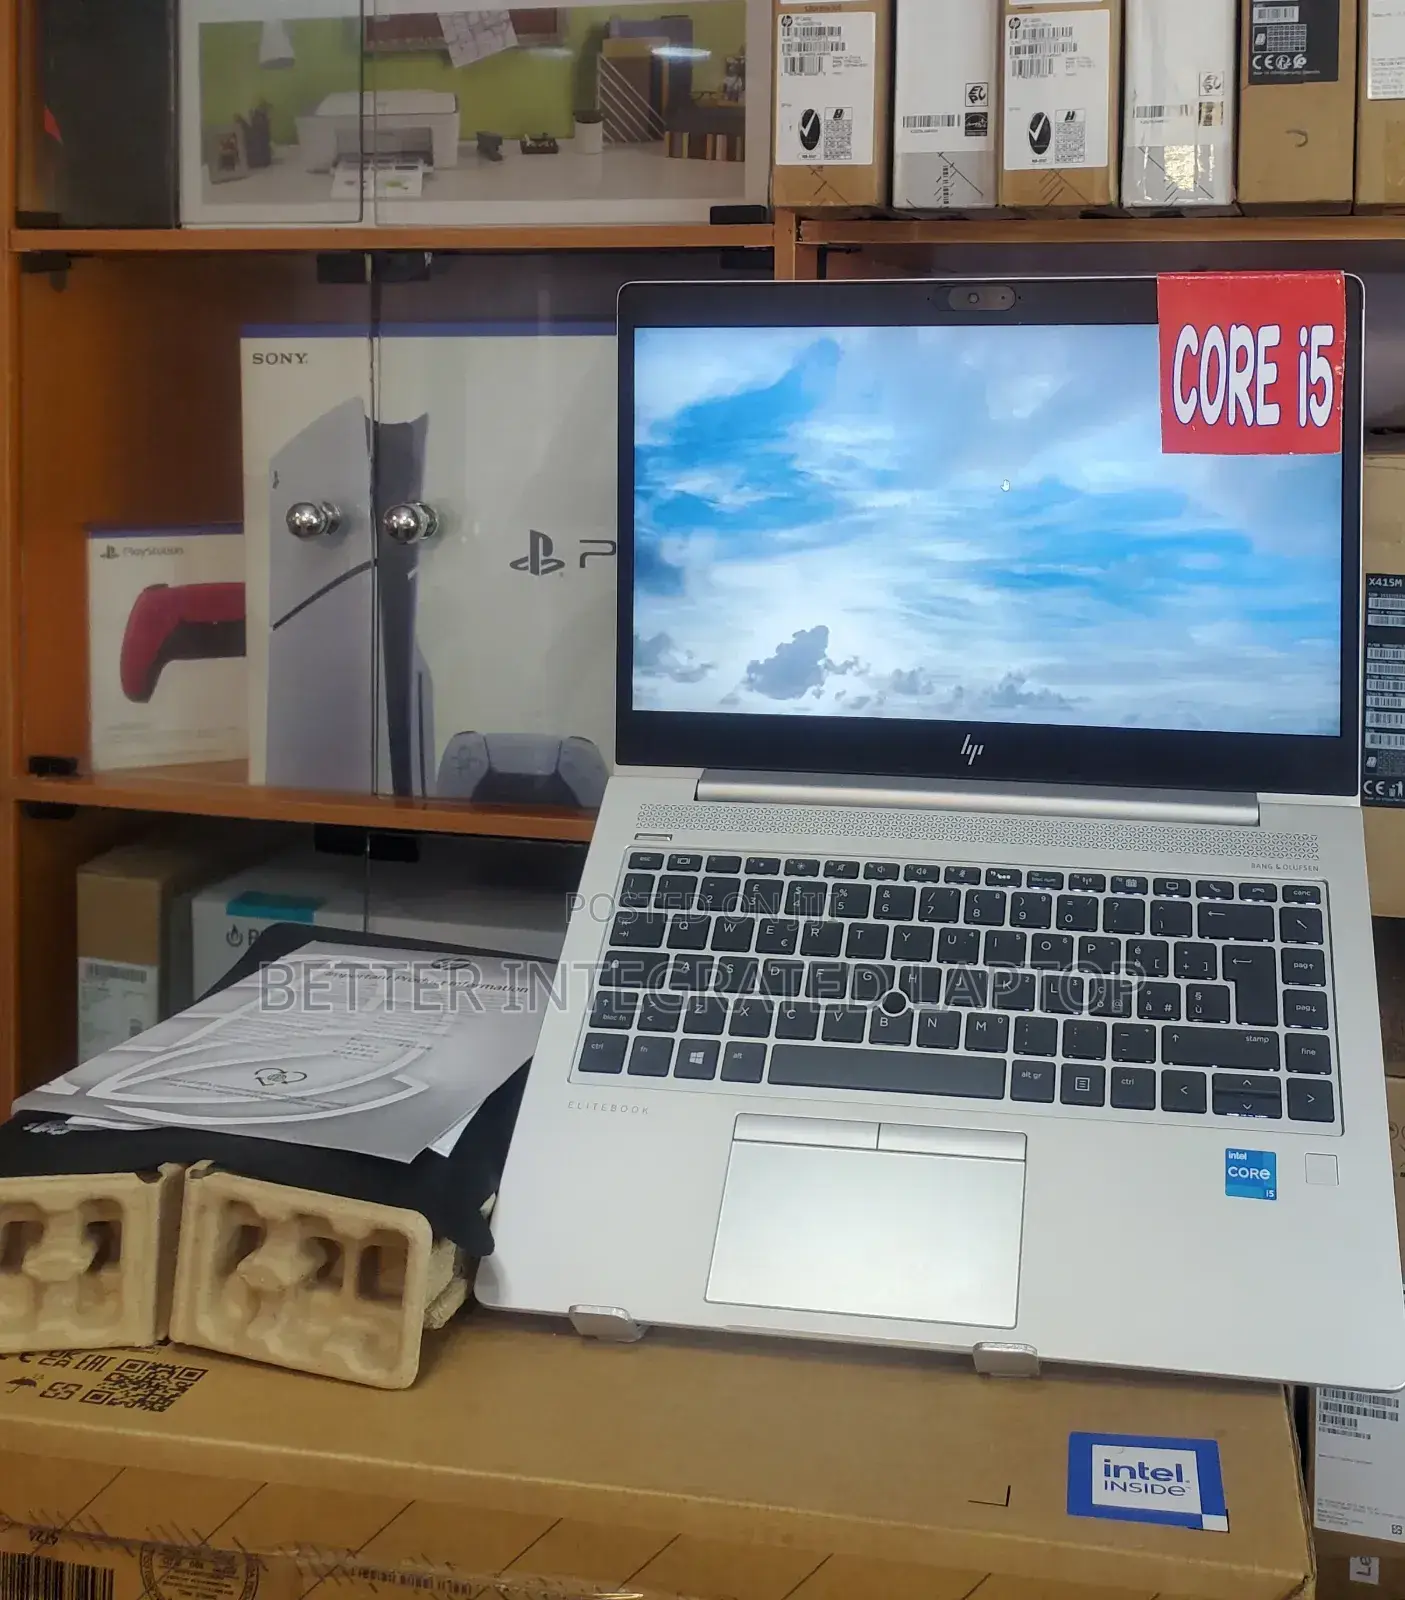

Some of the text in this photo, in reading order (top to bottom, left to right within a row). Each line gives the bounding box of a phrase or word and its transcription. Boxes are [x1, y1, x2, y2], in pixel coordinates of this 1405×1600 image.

[252, 352, 309, 365] SONY
[1172, 324, 1335, 428] CORE i5
[1251, 862, 1273, 870] BANG
[1282, 864, 1319, 872] OLUFSEN
[679, 921, 689, 931] Q
[723, 923, 737, 932] W
[766, 925, 774, 934] E
[811, 928, 820, 937] R
[856, 930, 864, 939] T
[902, 932, 911, 942] Y
[780, 939, 788, 947] €
[948, 935, 957, 944] U
[1088, 944, 1096, 953] P
[1293, 962, 1308, 970] pag
[694, 1004, 703, 1014] Z
[740, 1006, 750, 1017] X
[786, 1009, 796, 1020] C
[833, 1012, 844, 1022] V
[880, 1017, 889, 1027] B
[928, 1018, 937, 1028] N
[976, 1021, 987, 1031] M
[1245, 1035, 1270, 1044] stamp
[590, 1042, 604, 1050] ctrl
[732, 1051, 743, 1059] alt
[1301, 1047, 1316, 1056] fine
[1021, 1070, 1042, 1080] alt gr
[1121, 1078, 1135, 1086] ctrl
[567, 1100, 649, 1115] ELITEBOOK
[1228, 1151, 1247, 1161] intel
[1266, 1189, 1275, 1198] i5
[1104, 1458, 1184, 1483] intel
